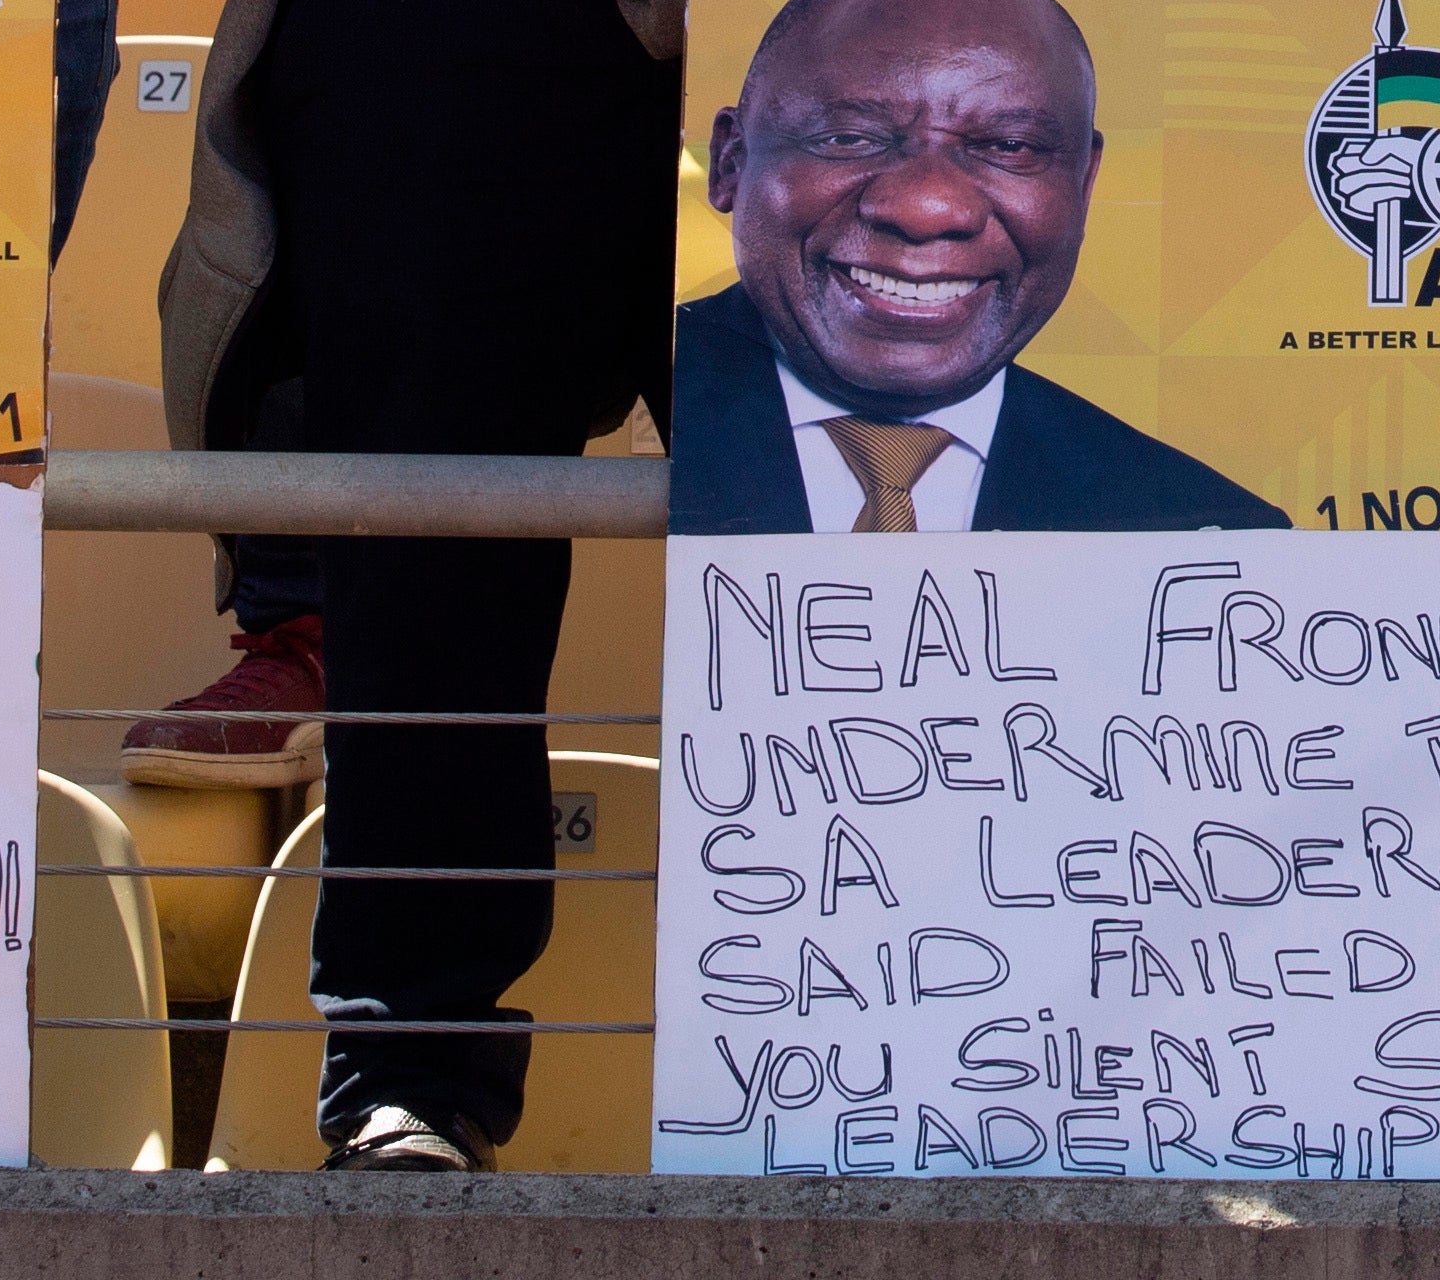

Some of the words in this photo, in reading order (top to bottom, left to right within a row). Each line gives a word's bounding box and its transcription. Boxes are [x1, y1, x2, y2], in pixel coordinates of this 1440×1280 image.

[143, 71, 187, 102] 27
[1279, 331, 1299, 350] A
[1308, 331, 1418, 351] BETTER
[1317, 495, 1339, 530] 1
[703, 562, 1057, 712] NEAL
[681, 703, 1353, 817] UNDERMINE
[701, 814, 898, 916] SA
[699, 927, 1011, 1016] SAID
[1091, 918, 1417, 999] FAILED
[763, 1099, 1440, 1178] LEADERSHIP
